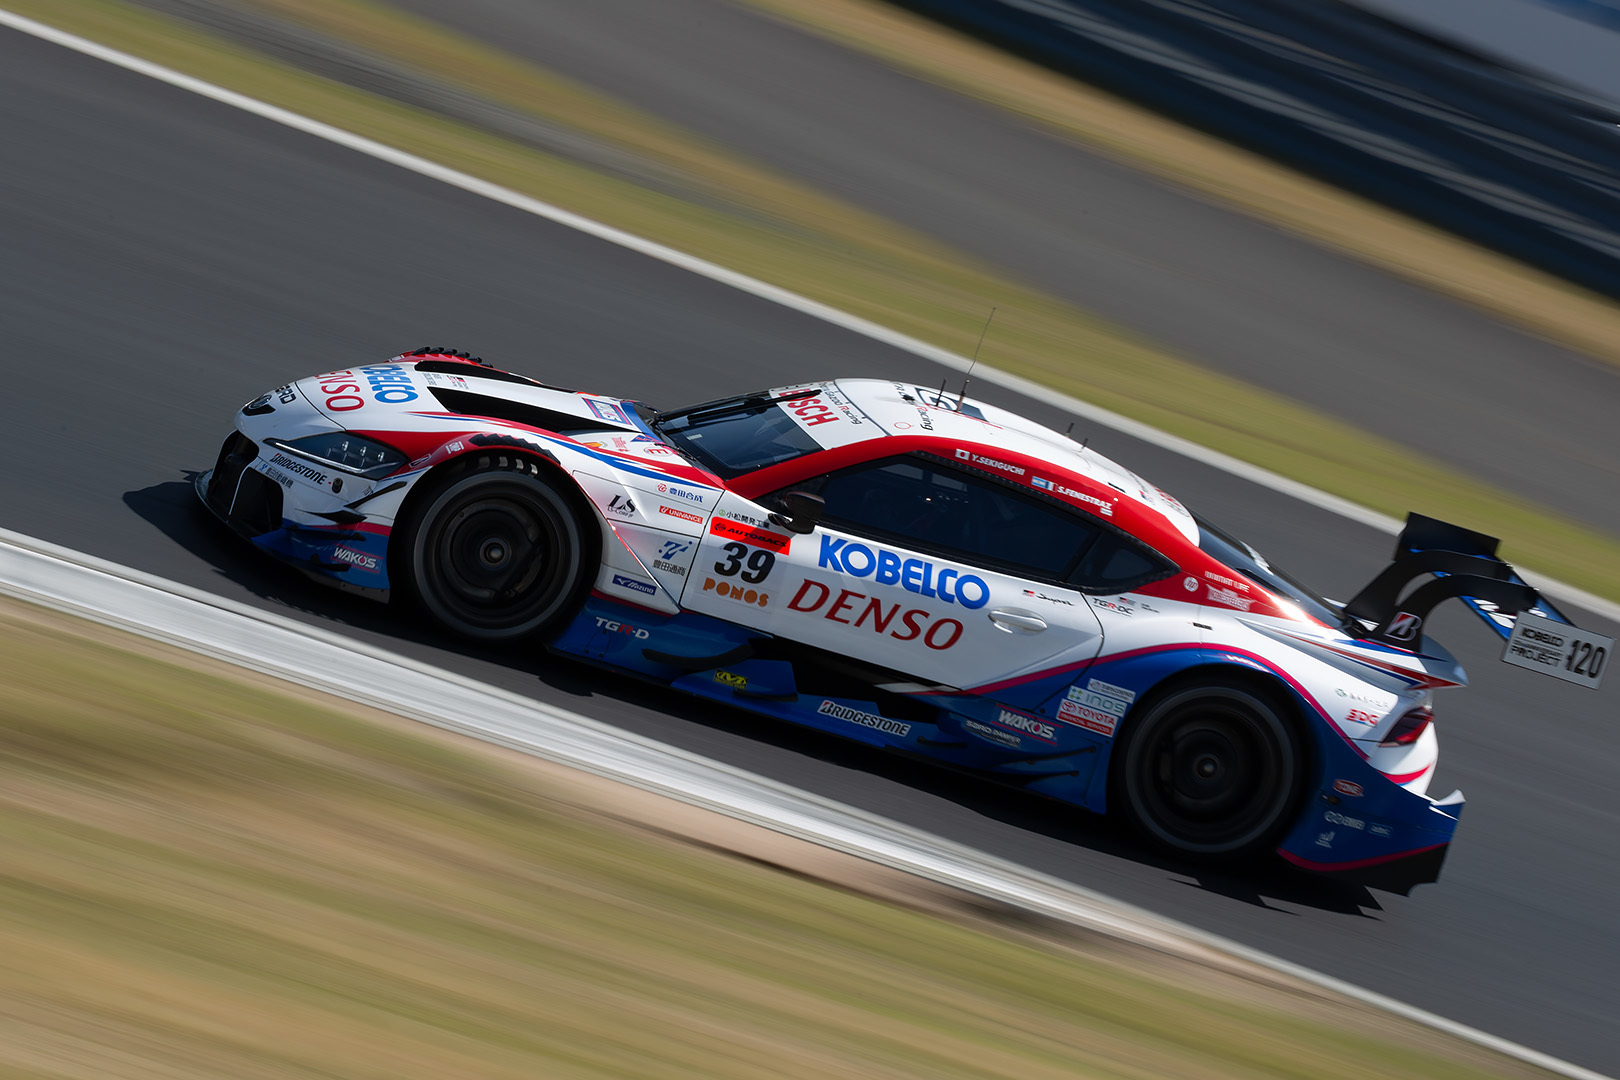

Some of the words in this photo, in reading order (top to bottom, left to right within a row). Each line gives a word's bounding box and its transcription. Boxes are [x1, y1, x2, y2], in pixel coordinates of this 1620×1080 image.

[314, 370, 364, 412] ENSO
[359, 365, 418, 403] OBELCO
[778, 388, 840, 427] BSCH
[269, 453, 328, 485] BRIDGESTONE
[971, 454, 1025, 476] Y.SEKIGUCHI
[1057, 485, 1113, 510] S.FENESTRAZ
[669, 509, 702, 523] UNIVANCE
[728, 527, 787, 548] AUTOBACS
[713, 542, 776, 584] 39
[818, 533, 990, 610] KOBELCO
[702, 577, 769, 608] PONOS
[595, 616, 650, 640] TGR-D
[787, 578, 964, 651] DENSO
[1510, 645, 1564, 667] PROJECT
[817, 700, 911, 736] BRIDGESTONE
[1078, 706, 1117, 726] TOYOTA
